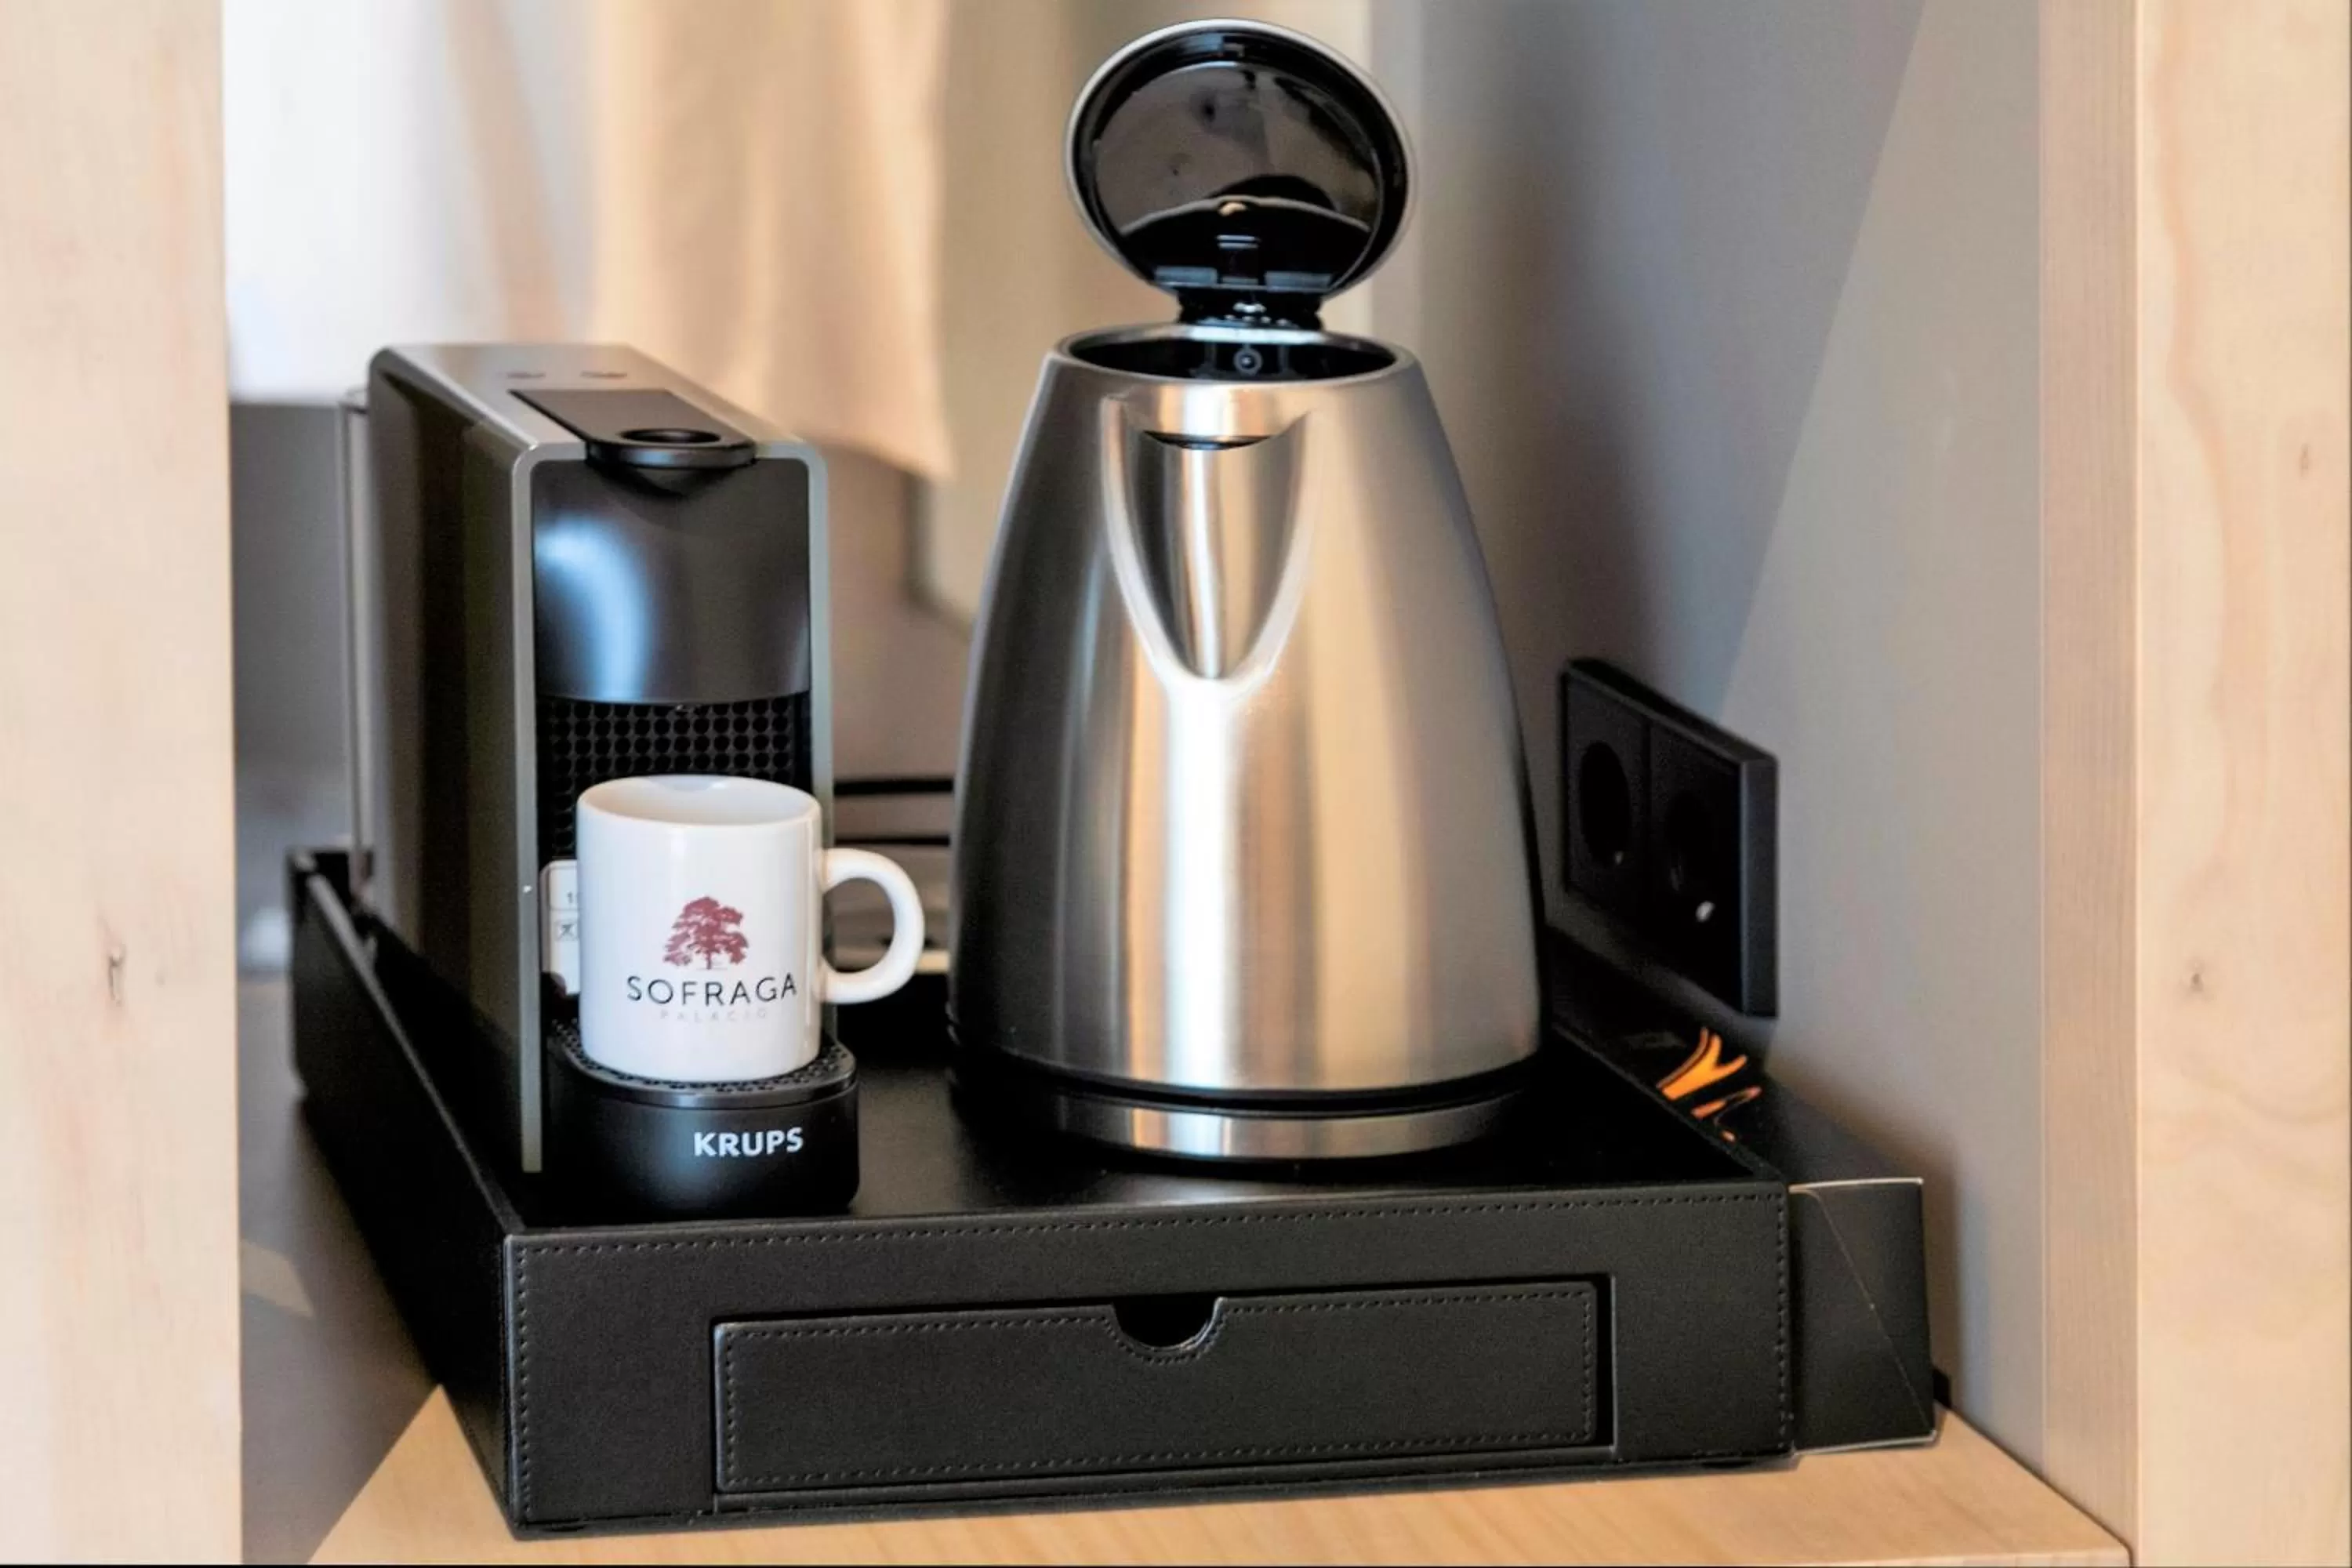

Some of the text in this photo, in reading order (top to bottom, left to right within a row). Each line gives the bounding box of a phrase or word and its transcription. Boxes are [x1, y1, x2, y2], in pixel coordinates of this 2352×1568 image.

[626, 971, 797, 1006] SOFRAGA
[659, 1007, 768, 1023] PALACIO
[693, 1126, 804, 1157] KRUPS
